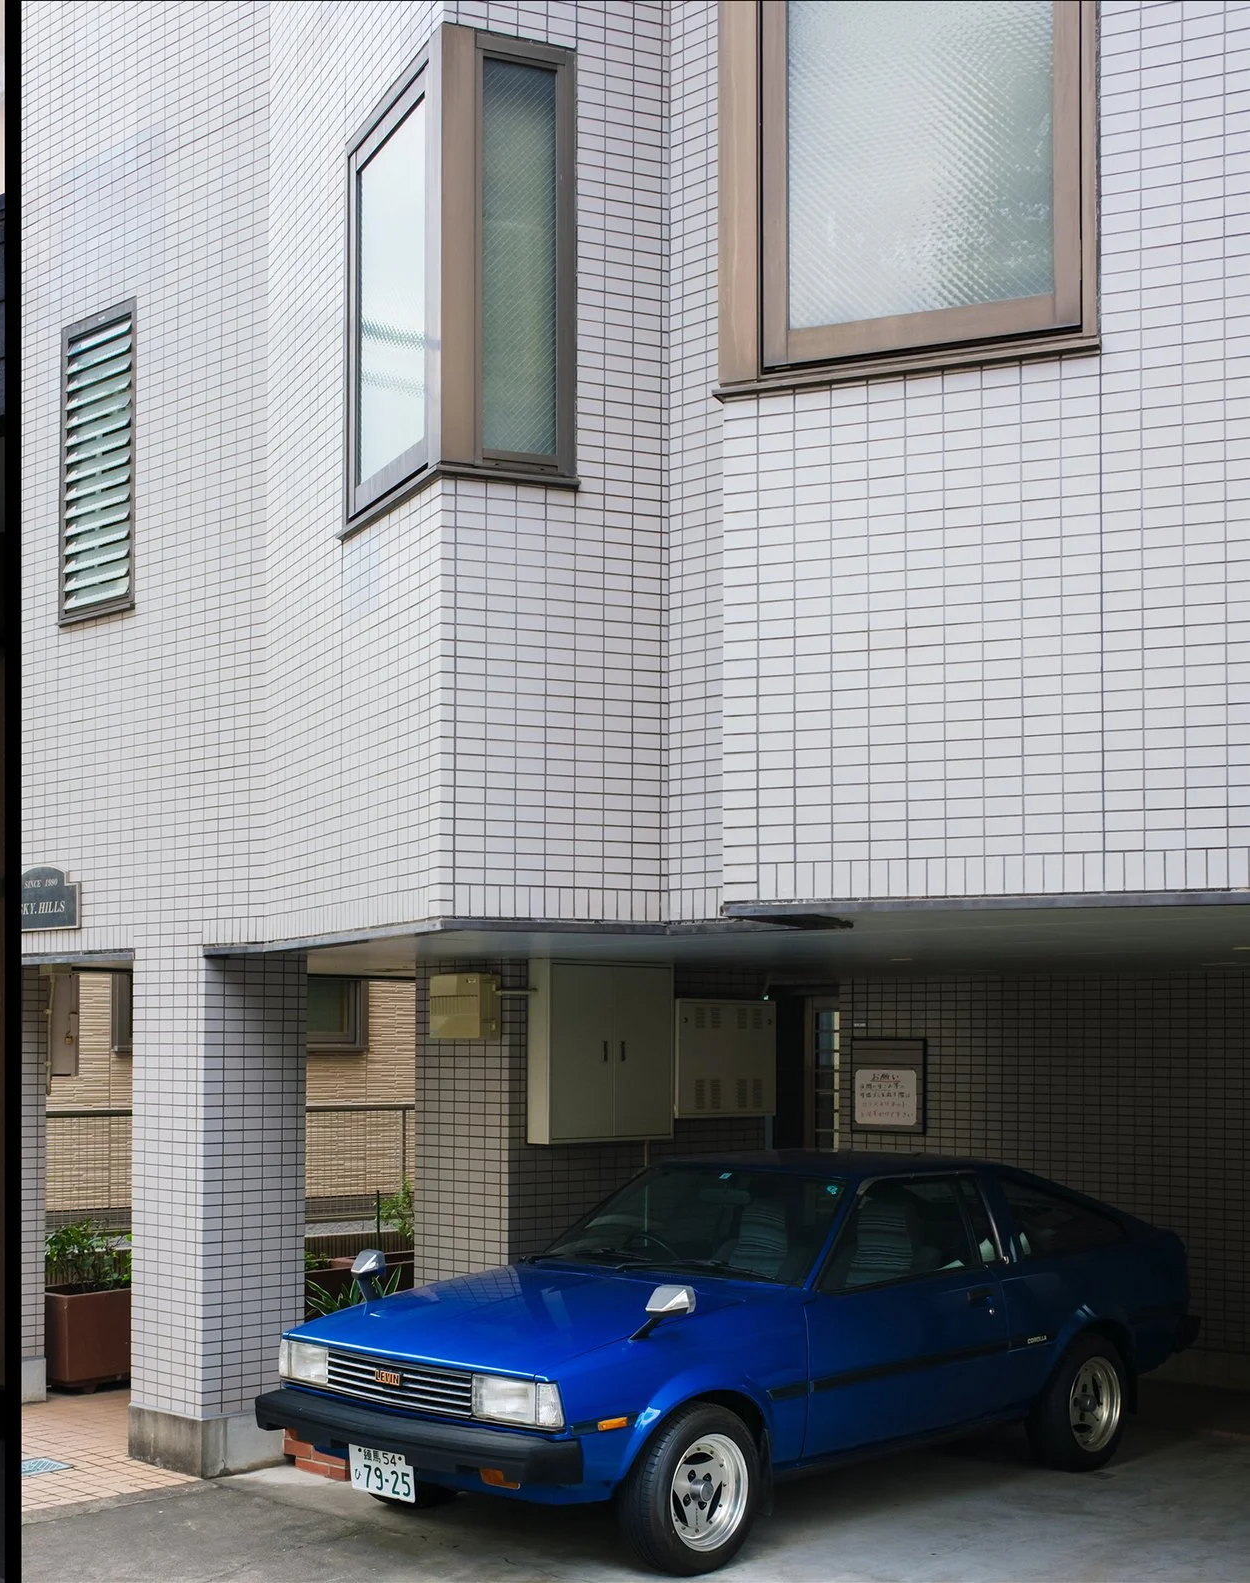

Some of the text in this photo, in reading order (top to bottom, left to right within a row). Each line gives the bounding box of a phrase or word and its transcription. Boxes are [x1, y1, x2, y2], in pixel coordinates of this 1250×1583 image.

[24, 880, 41, 889] SINCE
[21, 900, 66, 916] KY.HILLS
[375, 1370, 400, 1386] LEVIN
[382, 1452, 397, 1467] 54
[363, 1463, 411, 1498] 79-25
